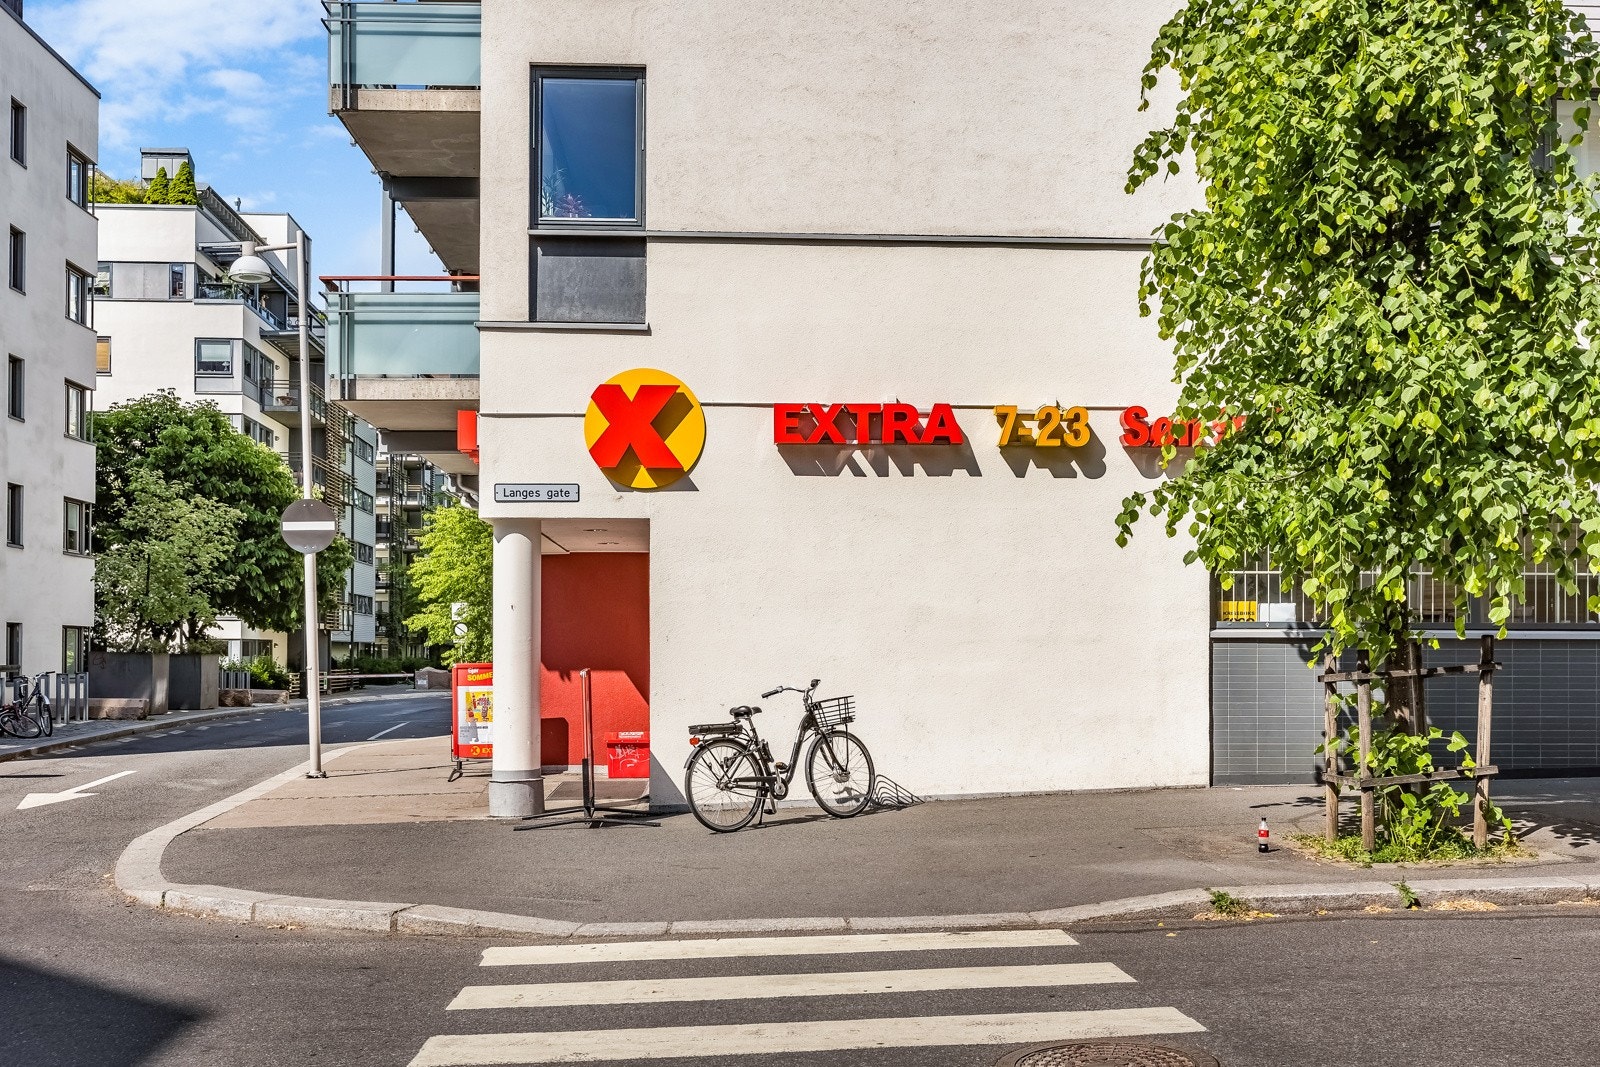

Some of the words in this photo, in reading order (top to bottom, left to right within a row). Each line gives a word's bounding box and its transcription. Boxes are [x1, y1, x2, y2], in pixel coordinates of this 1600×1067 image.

[774, 403, 963, 445] EXTRA
[993, 405, 1090, 447] 7-23
[503, 488, 541, 499] Langes
[546, 488, 571, 499] gate
